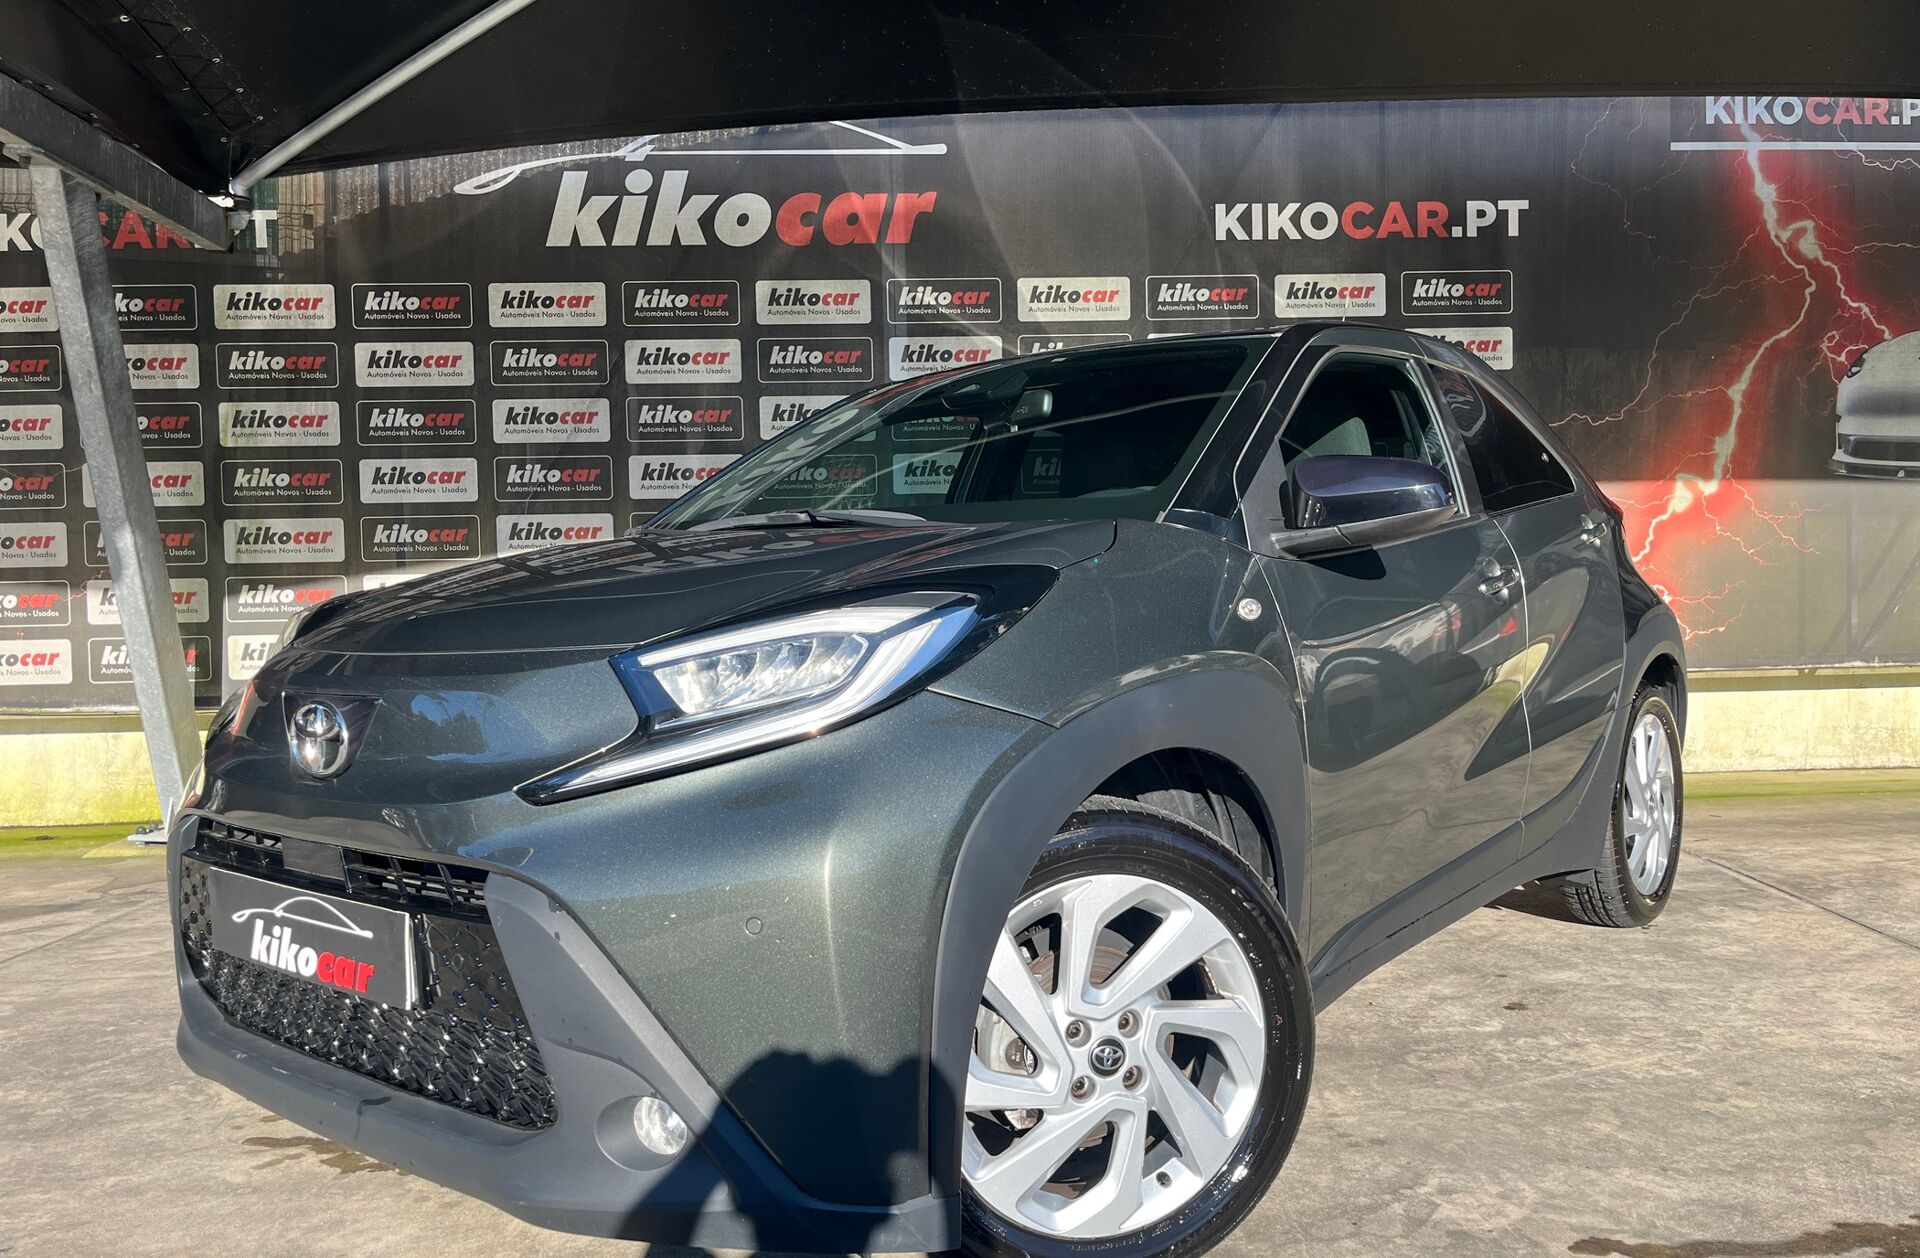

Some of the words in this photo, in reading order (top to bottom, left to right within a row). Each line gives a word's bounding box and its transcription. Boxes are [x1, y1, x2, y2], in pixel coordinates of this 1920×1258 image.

[546, 169, 937, 247] kikocar
[1215, 200, 1529, 241] KIKOCAR.PT
[767, 287, 860, 306] kikocar
[898, 286, 990, 305] kikocar
[1028, 284, 1119, 303] kikocar
[1157, 282, 1247, 302] kikocar
[1286, 280, 1374, 300] kikocar
[1413, 278, 1501, 297] kikocar
[115, 292, 184, 312] kocar
[226, 291, 322, 311] kikocar
[364, 290, 460, 310] kikocar
[500, 289, 594, 309] kikocar
[634, 288, 728, 307] kikocar
[1285, 301, 1322, 309] Automóveis
[435, 311, 461, 319] Usados
[542, 310, 564, 318] Novos
[634, 309, 673, 317] Automóveis
[1028, 305, 1066, 313] Automóveis
[22, 315, 48, 323] Usados
[127, 354, 187, 371] ocar
[228, 350, 325, 370] kikocar
[367, 349, 462, 369] kikocar
[502, 347, 596, 367] kikocar
[636, 346, 730, 365] kikocar
[769, 345, 861, 364] kikocar
[900, 343, 991, 363] kikocar
[24, 374, 50, 382] Usados
[636, 367, 675, 375] Automóveis
[137, 414, 189, 430] ocar
[231, 408, 327, 428] kikocar
[368, 407, 464, 427] kikocar
[504, 405, 598, 425] kikocar
[638, 403, 731, 423] kikocar
[142, 431, 158, 439] ovos
[231, 430, 271, 438] Automóveis
[302, 429, 328, 437] Usados
[411, 428, 433, 436] Novos
[234, 467, 330, 487] kikocar
[371, 465, 466, 485] kikocar
[506, 463, 600, 483] kikocar
[640, 461, 722, 481] kikoca
[904, 460, 957, 477] kiko
[166, 489, 193, 497] Usados
[506, 484, 545, 492] Automóveis
[576, 483, 601, 491] Usados
[236, 525, 332, 545] kikocar
[373, 523, 468, 543] kikocar
[508, 520, 602, 540] kikocar
[0, 534, 56, 550] ocar
[279, 546, 301, 554] Novos
[443, 543, 469, 551] Usados
[1, 551, 24, 559] Novos
[238, 583, 334, 603] kikocar
[32, 609, 59, 617] Usados
[176, 606, 197, 614] sados
[238, 605, 278, 613] Automóveis
[251, 919, 375, 993] kikocar
